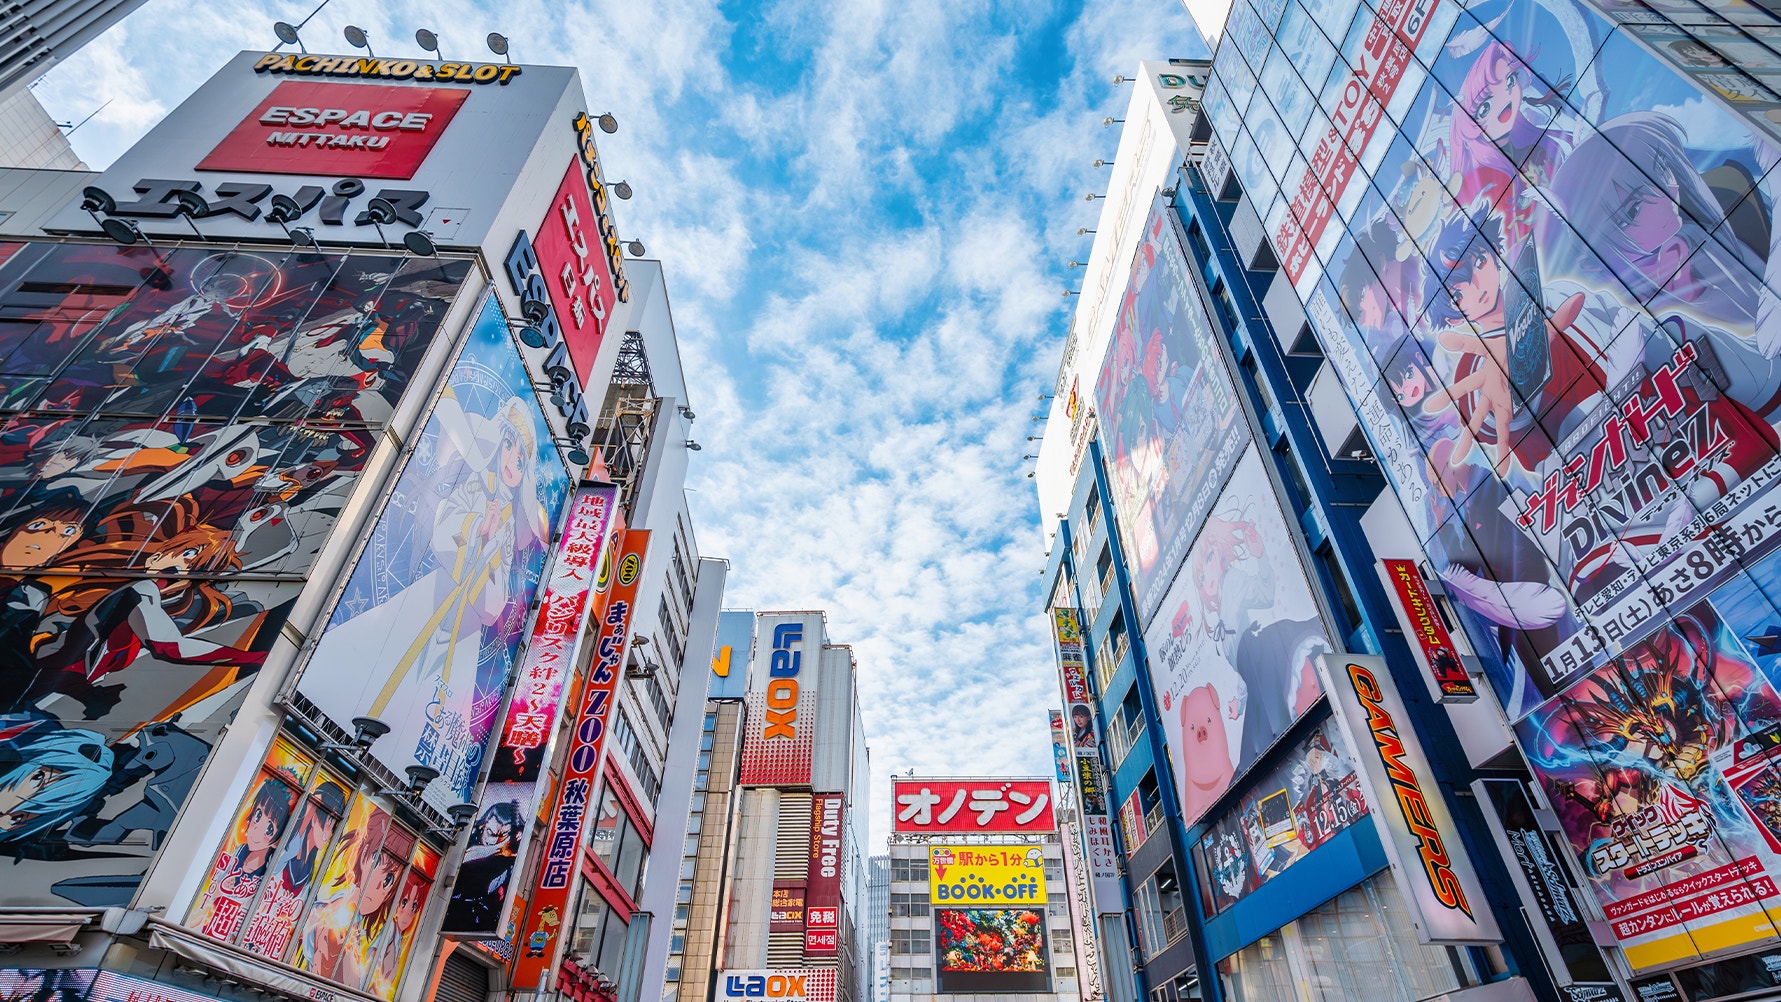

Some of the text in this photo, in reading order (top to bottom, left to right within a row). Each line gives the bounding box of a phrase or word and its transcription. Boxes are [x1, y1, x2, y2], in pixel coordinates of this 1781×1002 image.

[258, 106, 432, 131] ESPACE
[266, 132, 390, 149] NITTAKU
[112, 178, 429, 227] エスパス
[1289, 94, 1382, 278] ホビーランドぽち
[560, 193, 605, 334] エスパス
[561, 262, 587, 330] 日拓
[1573, 453, 1781, 620] テレビ愛知・テレビ東京系列6局ネットに
[592, 600, 630, 686] まぁじゃん
[572, 689, 613, 775] ZOO
[897, 782, 1049, 826] オノデン
[1346, 662, 1477, 926] GAMERS
[1612, 805, 1659, 838] クイック
[541, 779, 589, 890] 秋葉原店
[812, 798, 824, 859] Flagship Store
[820, 798, 842, 878] Duty Free
[958, 851, 1022, 867] 駅から1分
[1594, 810, 1714, 874] スタートデッキ
[808, 935, 835, 945] 면세점
[810, 911, 835, 923] 免税
